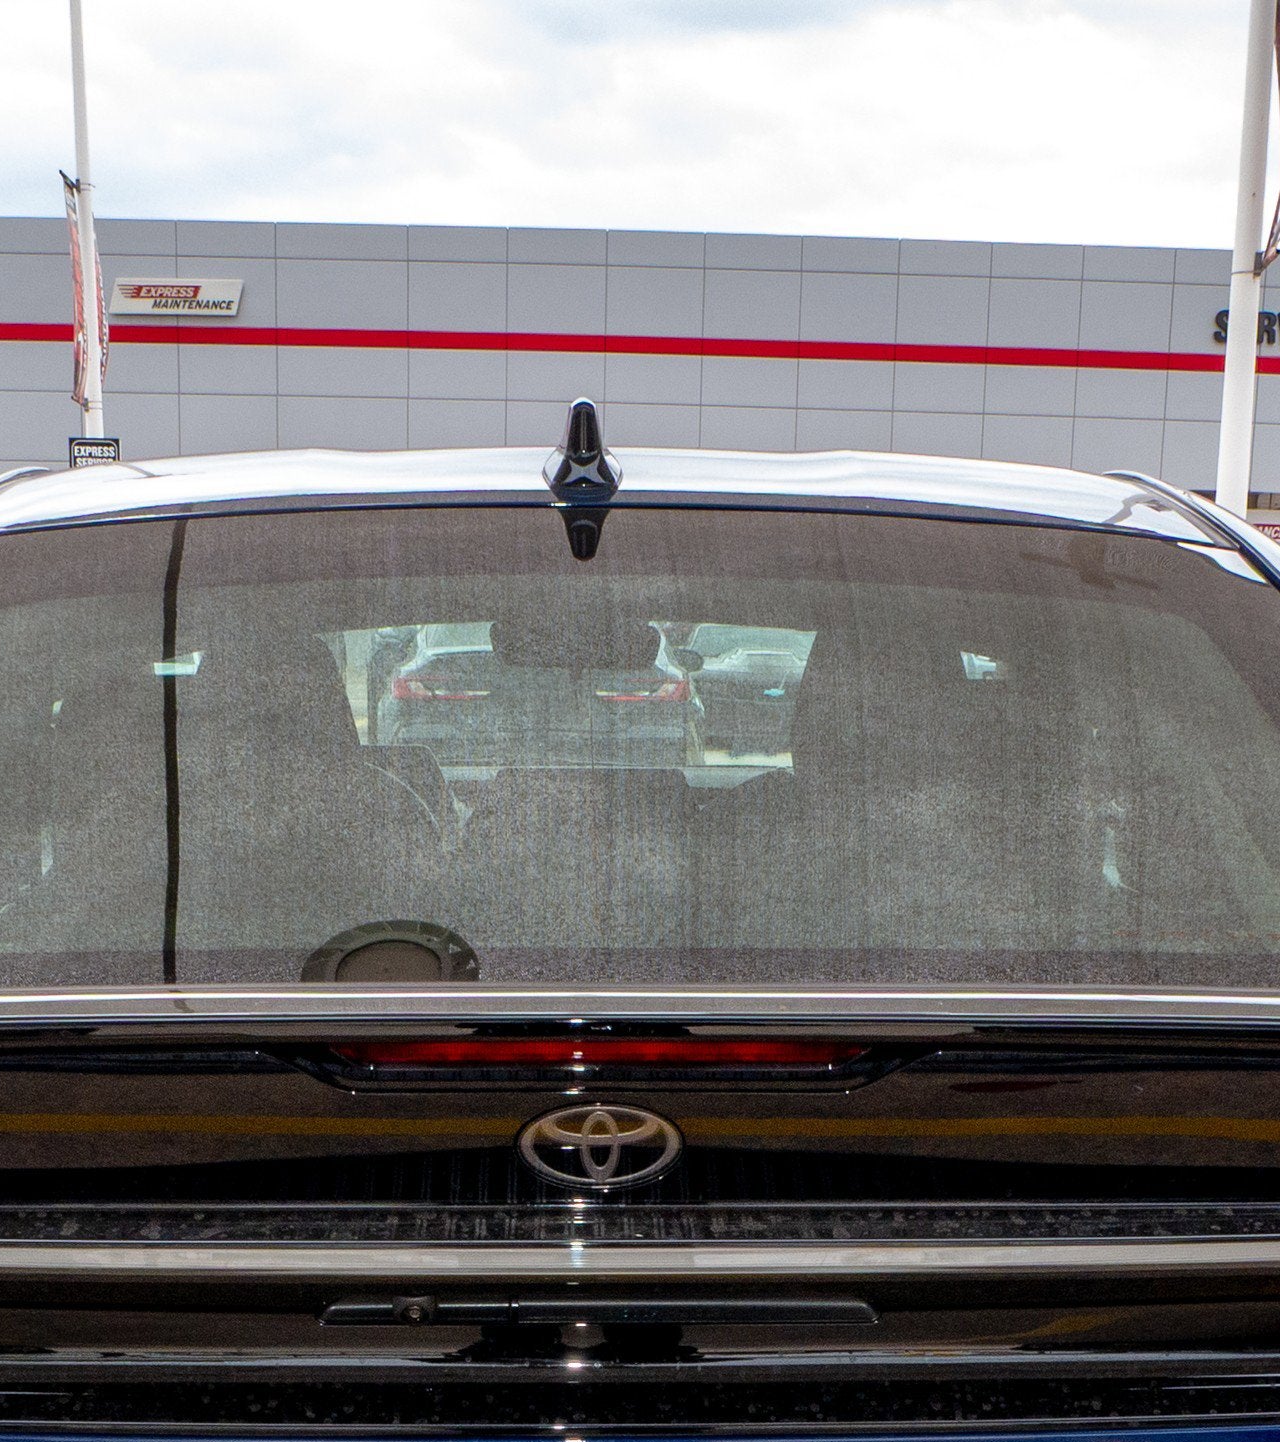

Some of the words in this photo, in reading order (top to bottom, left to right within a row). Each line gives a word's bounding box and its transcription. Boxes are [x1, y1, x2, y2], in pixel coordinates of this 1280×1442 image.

[140, 286, 195, 298] EXPRESS
[151, 299, 234, 311] MAINTENANCE
[74, 445, 116, 457] EXPRESS
